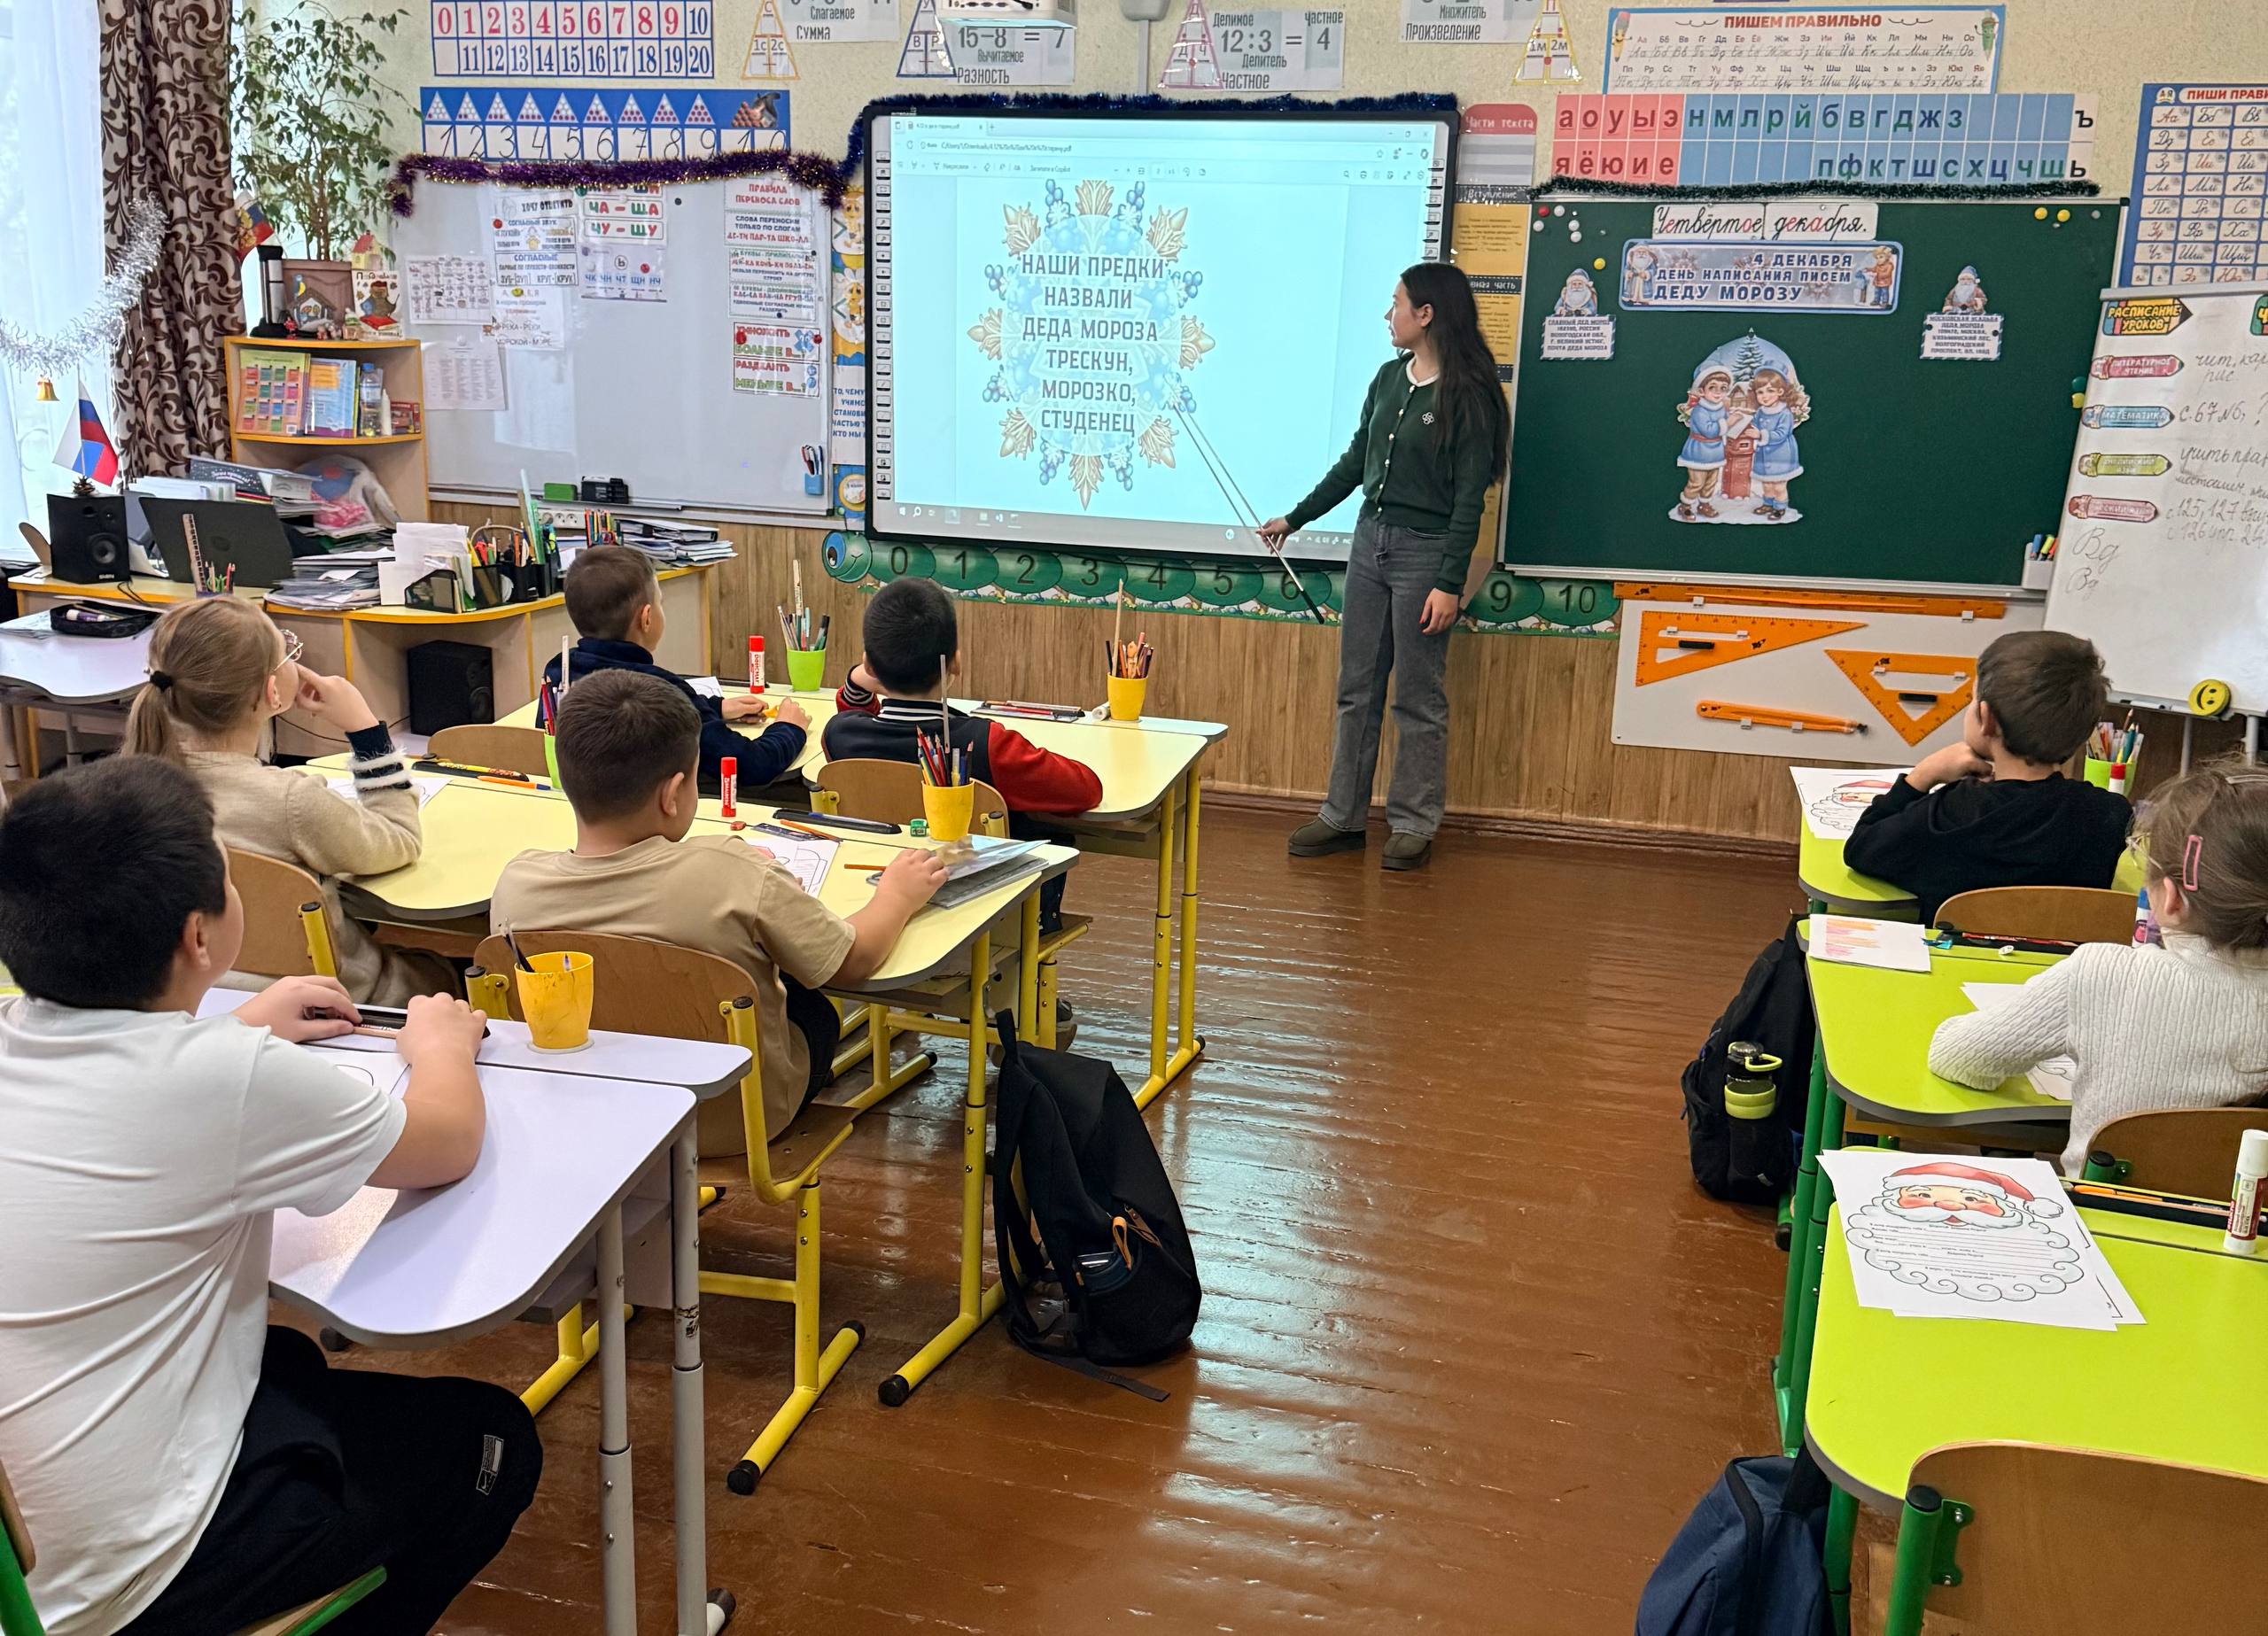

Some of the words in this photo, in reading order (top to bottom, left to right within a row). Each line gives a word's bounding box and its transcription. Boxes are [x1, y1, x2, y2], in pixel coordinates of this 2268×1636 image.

[811, 6, 855, 20] Слагаемое
[1439, 4, 1487, 19] Множитель
[438, 7, 452, 35] 0
[463, 7, 476, 35] 1
[487, 7, 501, 35] 2
[512, 7, 525, 35] 3
[536, 7, 551, 34] 4
[563, 7, 577, 35] 5
[587, 7, 602, 35] 6
[612, 8, 626, 35] 7
[637, 6, 654, 35] 8
[664, 7, 679, 35] 9
[689, 7, 708, 35] 10
[1213, 13, 1254, 27] Делимое
[1724, 16, 1783, 28] ПИШЕМ
[1785, 14, 1882, 28] ПРАВИЛЬНО
[796, 25, 831, 41] Сумма
[1317, 27, 1330, 50] 4
[1405, 23, 1481, 41] Произведение
[463, 45, 479, 71] 11
[486, 45, 505, 71] 12
[510, 45, 529, 72] 13
[535, 45, 554, 72] 14
[562, 45, 580, 73] 15
[587, 45, 606, 73] 16
[612, 45, 629, 73] 17
[637, 45, 657, 73] 18
[664, 45, 682, 73] 19
[689, 45, 710, 74] 20
[977, 49, 1024, 64] Вычитаемое
[1242, 54, 1287, 69] Делитель
[957, 66, 1010, 84] Разность
[1222, 73, 1270, 89] Частное
[2187, 89, 2227, 100] ПИШИ
[1502, 118, 1534, 128] текста
[1559, 109, 1573, 128] а
[1582, 109, 1599, 128] о
[1609, 109, 1624, 133] у
[1633, 109, 1655, 128] ы
[1664, 109, 1678, 128] э
[1689, 109, 1704, 127] н
[1714, 109, 1734, 127] м
[1740, 109, 1759, 128] л
[1767, 109, 1783, 133] р
[1795, 104, 1811, 128] й
[1822, 104, 1839, 128] б
[1849, 110, 1865, 128] в
[1875, 110, 1888, 128] г
[1893, 110, 1914, 133] д
[1918, 110, 1941, 128] ж
[1947, 110, 1962, 128] з
[2074, 110, 2093, 128] ъ
[440, 125, 454, 158] 1
[470, 126, 485, 160] 2
[499, 126, 516, 159] 3
[532, 125, 548, 159] 4
[564, 127, 582, 160] 5
[596, 128, 614, 161] 6
[632, 128, 649, 159] 7
[664, 127, 683, 160] 8
[699, 129, 717, 160] 9
[1556, 157, 1570, 174] я
[1579, 151, 1594, 174] ё
[1601, 157, 1623, 175] ю
[1633, 157, 1648, 174] и
[1659, 157, 1674, 175] е
[1818, 160, 1833, 178] п
[1838, 153, 1862, 180] ф
[1869, 159, 1884, 177] к
[1891, 159, 1907, 177] т
[1913, 159, 1936, 177] ш
[1943, 159, 1959, 178] с
[1969, 159, 1984, 177] х
[1991, 159, 2008, 181] ц
[2017, 159, 2032, 177] ч
[2070, 160, 2086, 178] ь
[749, 183, 788, 194] ПРАВИЛА
[1468, 189, 1517, 201] Вступление
[735, 195, 777, 205] ПЕРЕНОСА
[779, 197, 801, 205] СЛОВ
[589, 202, 609, 215] ЧА
[591, 223, 610, 235] ЧУ
[1657, 205, 1763, 240] Четвёртое
[1772, 204, 1867, 240] декабря.
[1753, 254, 1763, 265] 4
[1773, 254, 1852, 267] ДЕКАБРЯ
[1021, 254, 1080, 275] НАШИ
[1088, 256, 1164, 283] ПРЕДКИ
[1657, 268, 1695, 280] ДЕНЬ
[1703, 269, 1791, 281] НАПИСАНИЯ
[1799, 271, 1852, 283] ПИСЕМ
[1494, 281, 1516, 291] часть
[1654, 285, 1710, 300] ДЕДУ
[1720, 286, 1802, 301] МОРОЗУ
[1045, 286, 1132, 309] НАЗВАЛИ
[2109, 306, 2181, 317] РАСПИСАНИЕ
[1022, 317, 1072, 343] ДЕДА
[1081, 320, 1158, 341] МОРОЗА
[2122, 319, 2163, 331] УРОКОВ
[1046, 349, 1133, 376] ТРЕСКУН,
[1042, 379, 1136, 407] МОРОЗКО,
[2102, 411, 2166, 420] МАТЕМАТИКА
[1041, 409, 1135, 438] СТУДЕНЕЦ
[890, 546, 909, 576] 0
[955, 551, 967, 580] 1
[1017, 554, 1035, 585] 2
[1081, 557, 1099, 586] 3
[1147, 561, 1167, 591] 4
[1214, 566, 1233, 596] 5
[1490, 580, 1512, 613] 9
[1559, 584, 1595, 614] 10
